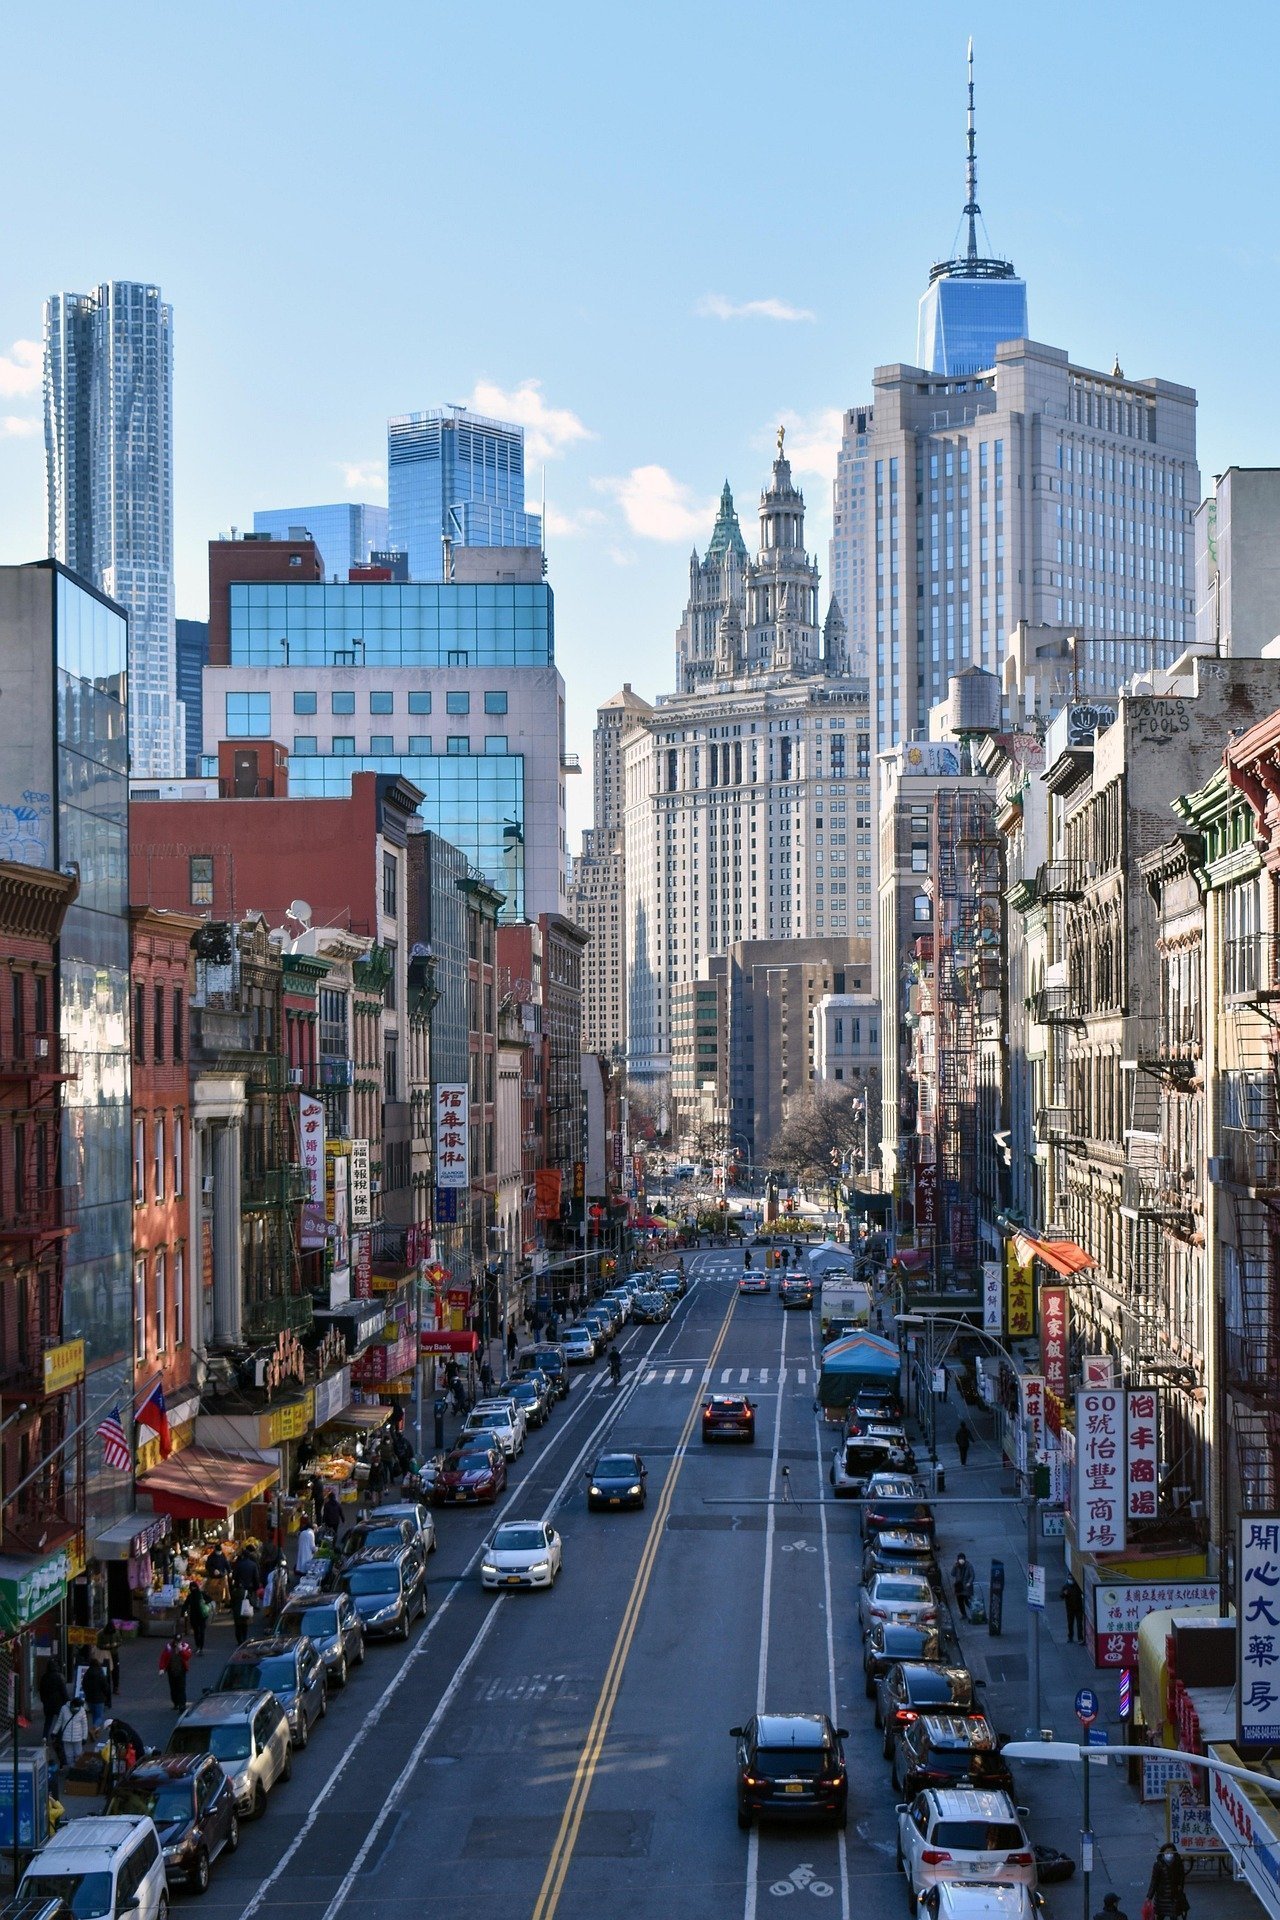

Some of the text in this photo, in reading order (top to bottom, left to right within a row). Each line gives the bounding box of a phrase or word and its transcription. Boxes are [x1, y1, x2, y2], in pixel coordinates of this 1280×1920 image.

[1009, 1255, 1031, 1332] 美商場
[1243, 1524, 1280, 1713] 開心大藥房
[1181, 1821, 1216, 1835] 郵政全
[1181, 1836, 1219, 1848] 郵寄全
